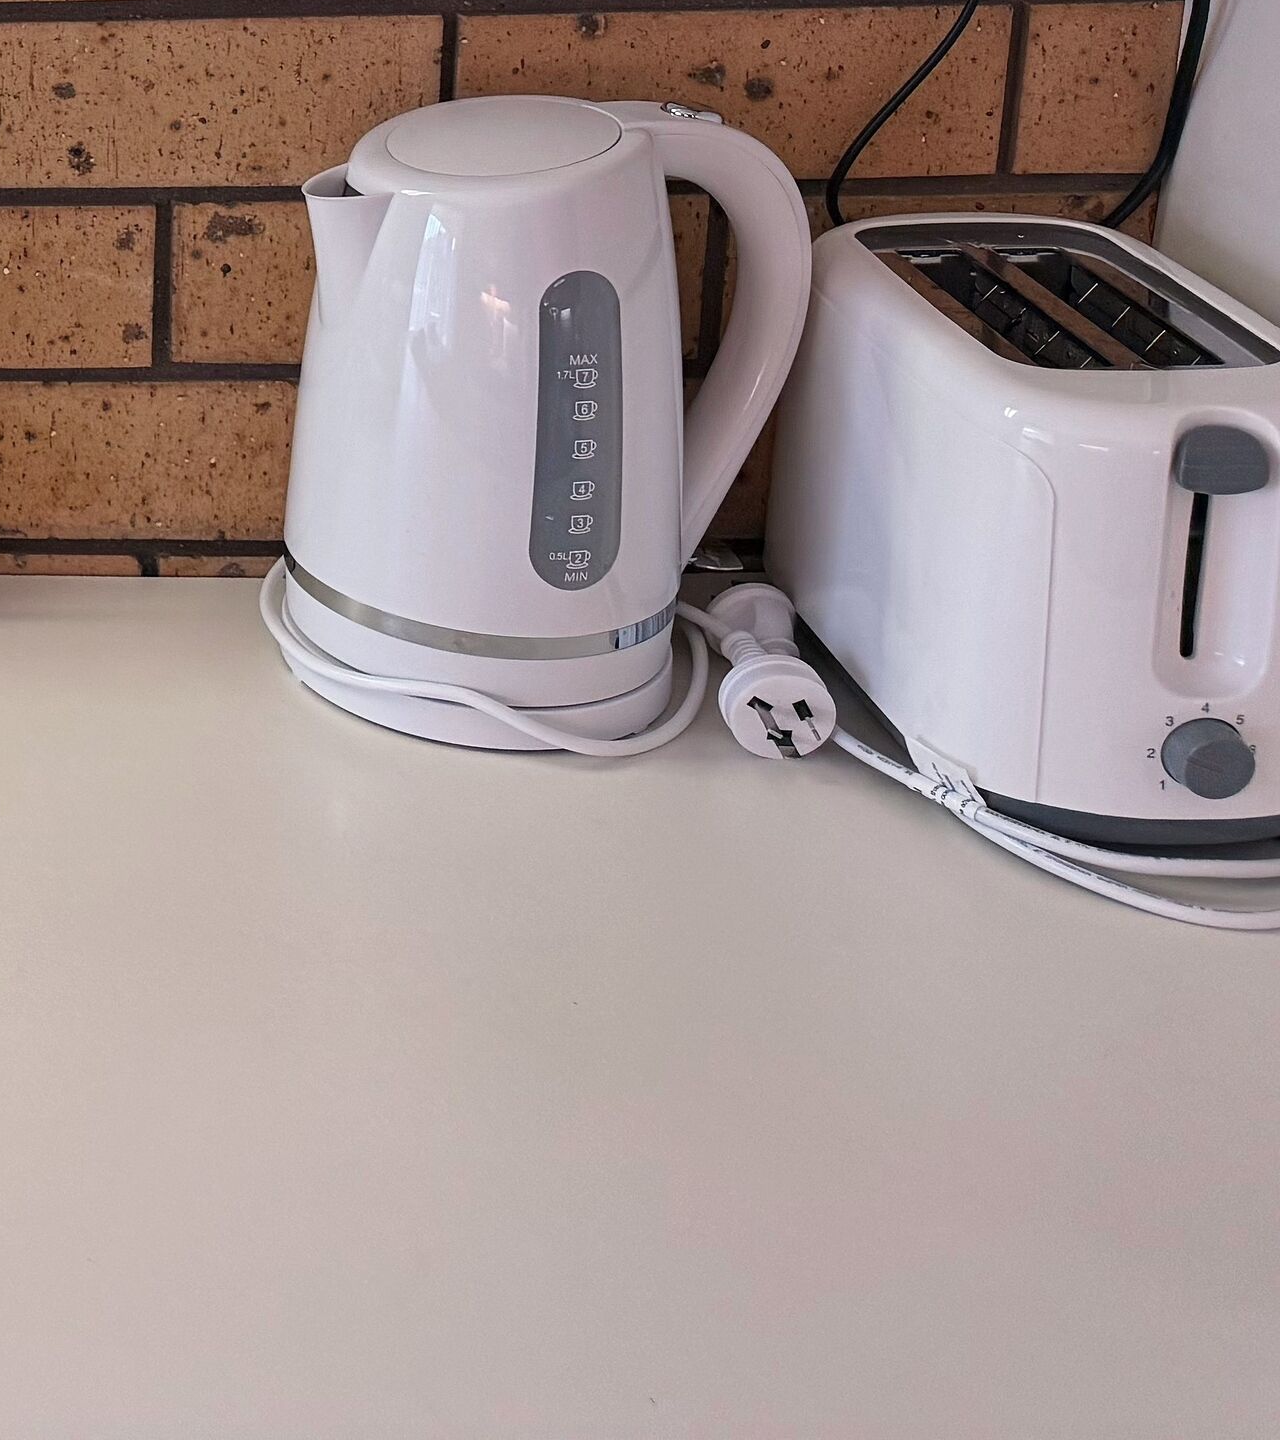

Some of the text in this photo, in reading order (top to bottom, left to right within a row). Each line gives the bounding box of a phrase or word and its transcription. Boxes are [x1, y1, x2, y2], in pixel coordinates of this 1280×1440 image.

[569, 353, 598, 366] MAX
[557, 370, 575, 380] 1.7L
[582, 371, 589, 382] 7
[581, 404, 589, 415] 6
[581, 442, 588, 453] 5
[579, 484, 586, 495] 4
[577, 518, 584, 528] 3
[549, 552, 567, 561] 0.5L
[575, 553, 582, 564] 2
[564, 571, 588, 582] MIN
[1201, 702, 1210, 713] 4
[1165, 716, 1174, 726] 3
[1235, 714, 1245, 725] 5
[1146, 748, 1156, 759] 2
[1159, 780, 1165, 790] 1
